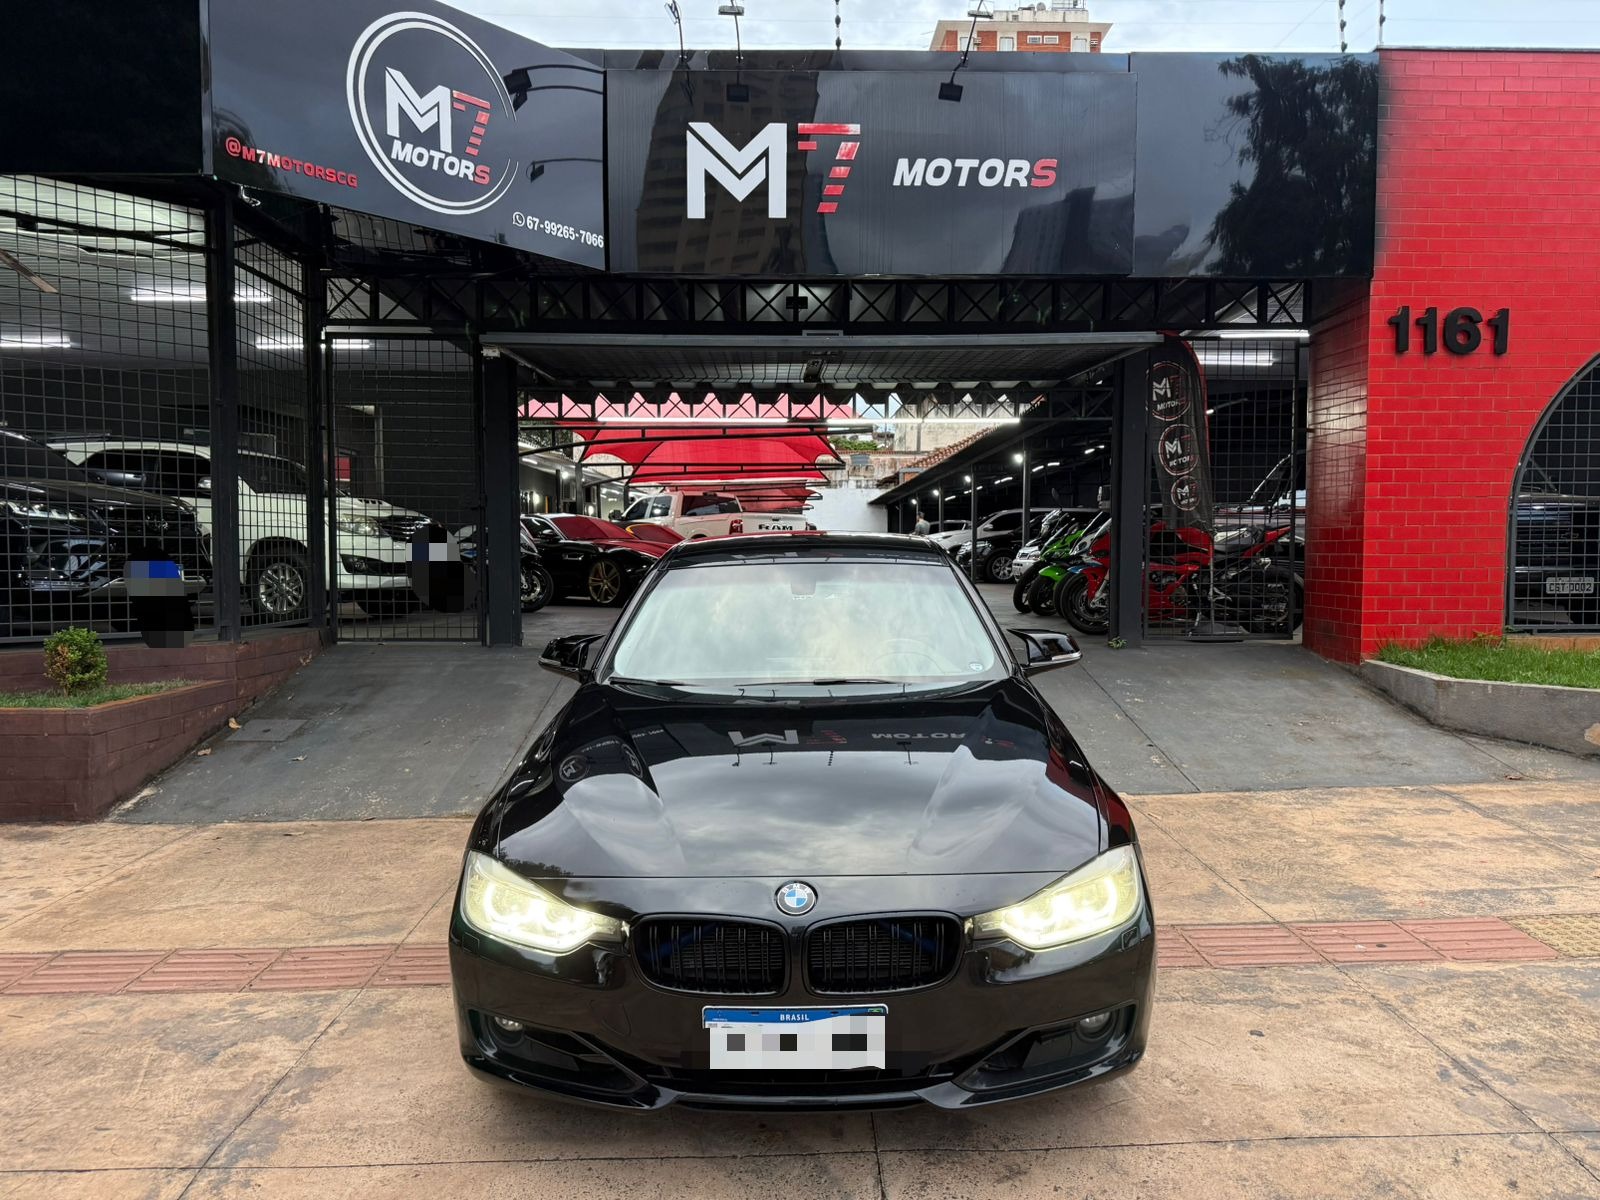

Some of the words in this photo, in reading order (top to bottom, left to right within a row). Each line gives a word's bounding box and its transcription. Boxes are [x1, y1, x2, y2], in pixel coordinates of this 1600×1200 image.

[385, 67, 491, 156] M7
[225, 136, 358, 188] @M7MOTORSCG
[390, 139, 491, 185] MOTORS
[686, 122, 861, 219] M7
[892, 158, 1058, 188] MOTORS
[526, 215, 604, 248] 67-99265-7066
[1387, 305, 1510, 355] 1161
[780, 1013, 810, 1022] BRASIL
